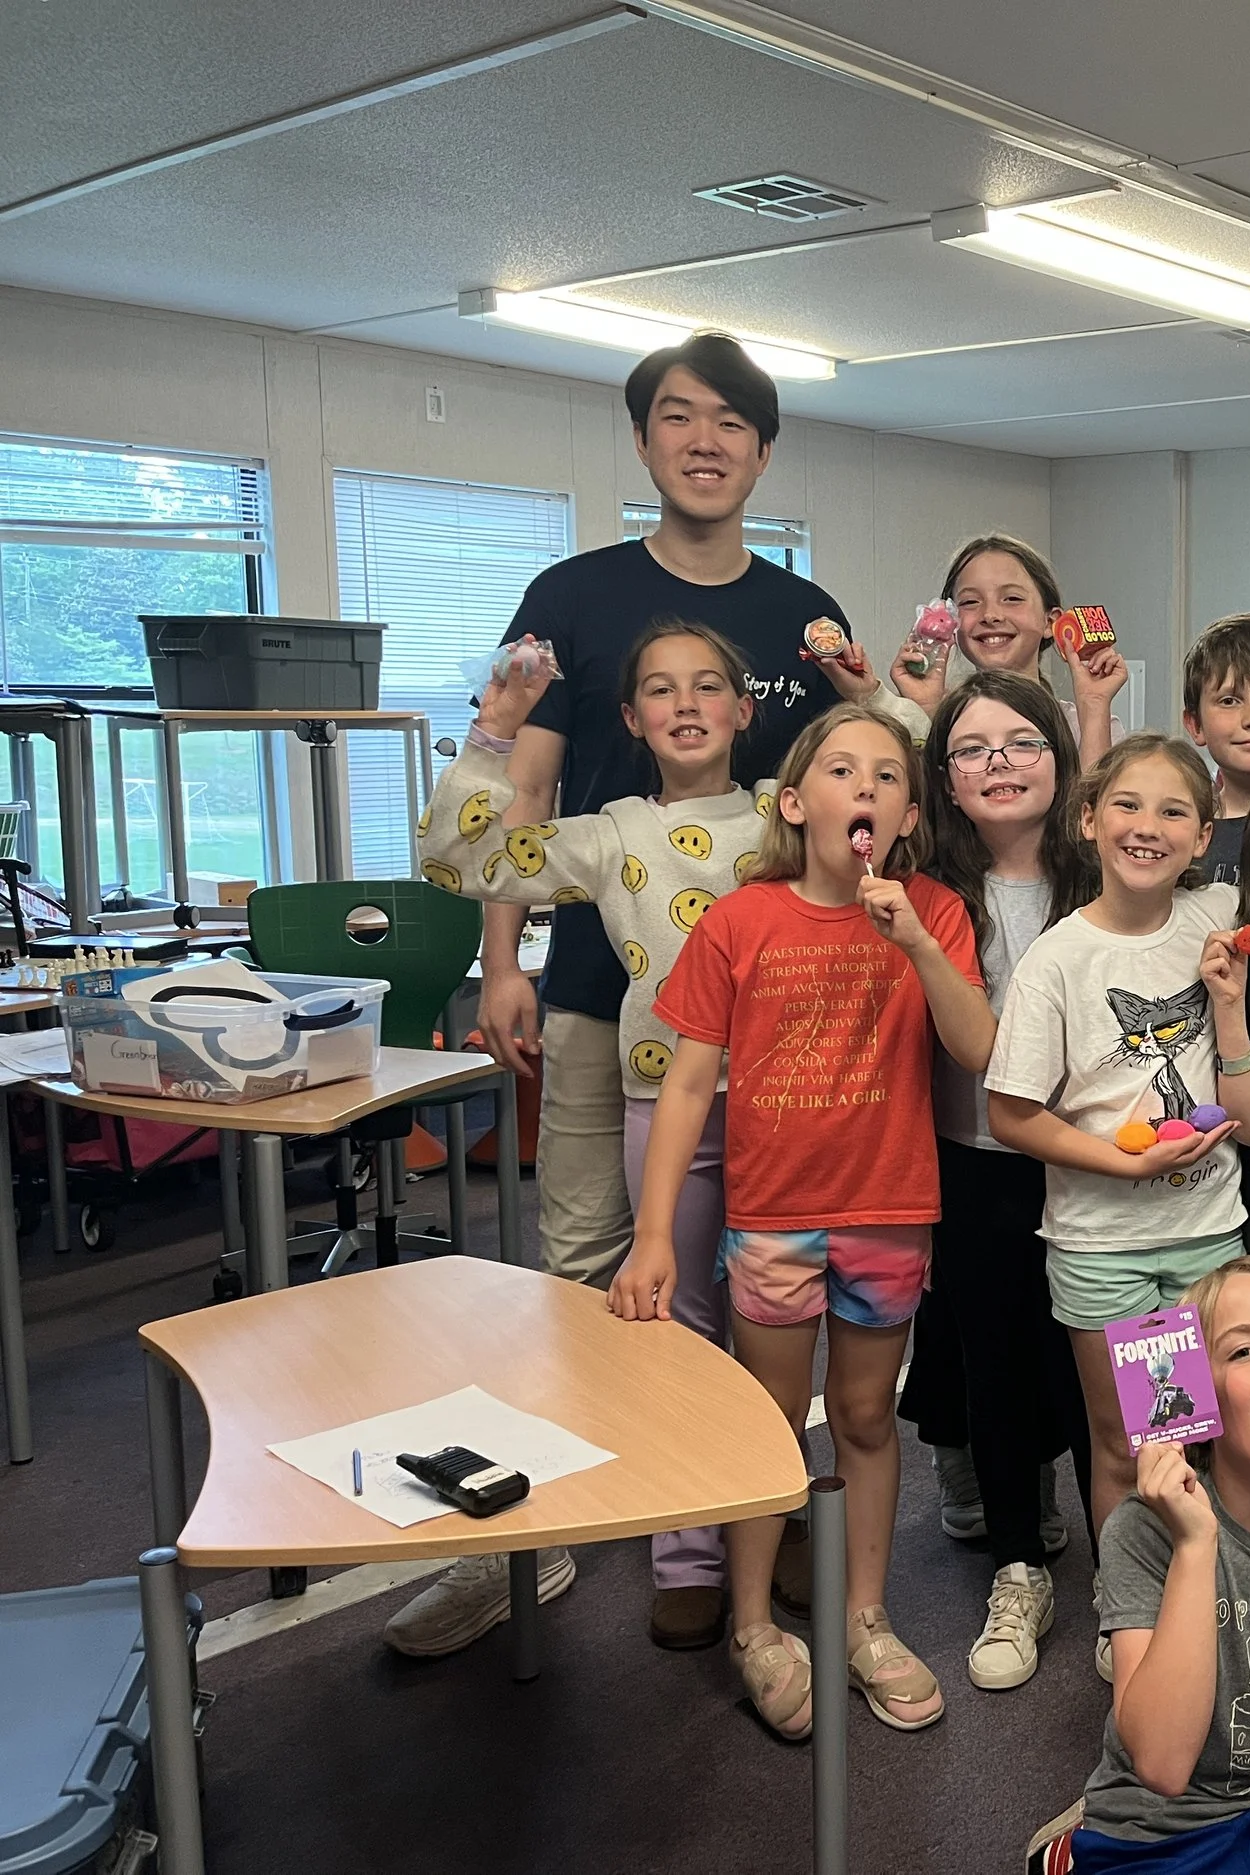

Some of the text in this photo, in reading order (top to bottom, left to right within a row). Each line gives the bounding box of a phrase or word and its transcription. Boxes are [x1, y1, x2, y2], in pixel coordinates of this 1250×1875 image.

[262, 639, 292, 649] BRUTE
[1084, 631, 1115, 643] COLOR
[743, 672, 807, 708] Story of You
[758, 944, 842, 964] QVAESTIONES
[763, 963, 819, 980] STRENVE
[750, 985, 787, 1000] ANIMI
[791, 981, 847, 996] AVCTVM
[784, 998, 868, 1014] PERSEVERATE
[776, 1018, 812, 1032] ALIOS
[833, 1053, 875, 1067] CAPITE
[811, 1073, 834, 1086] VIM
[752, 1094, 796, 1109] SOLVE
[800, 1094, 834, 1109] LIKE
[837, 1093, 849, 1106] A
[1113, 1325, 1200, 1368] FORTNITE
[1172, 1431, 1188, 1441] AND
